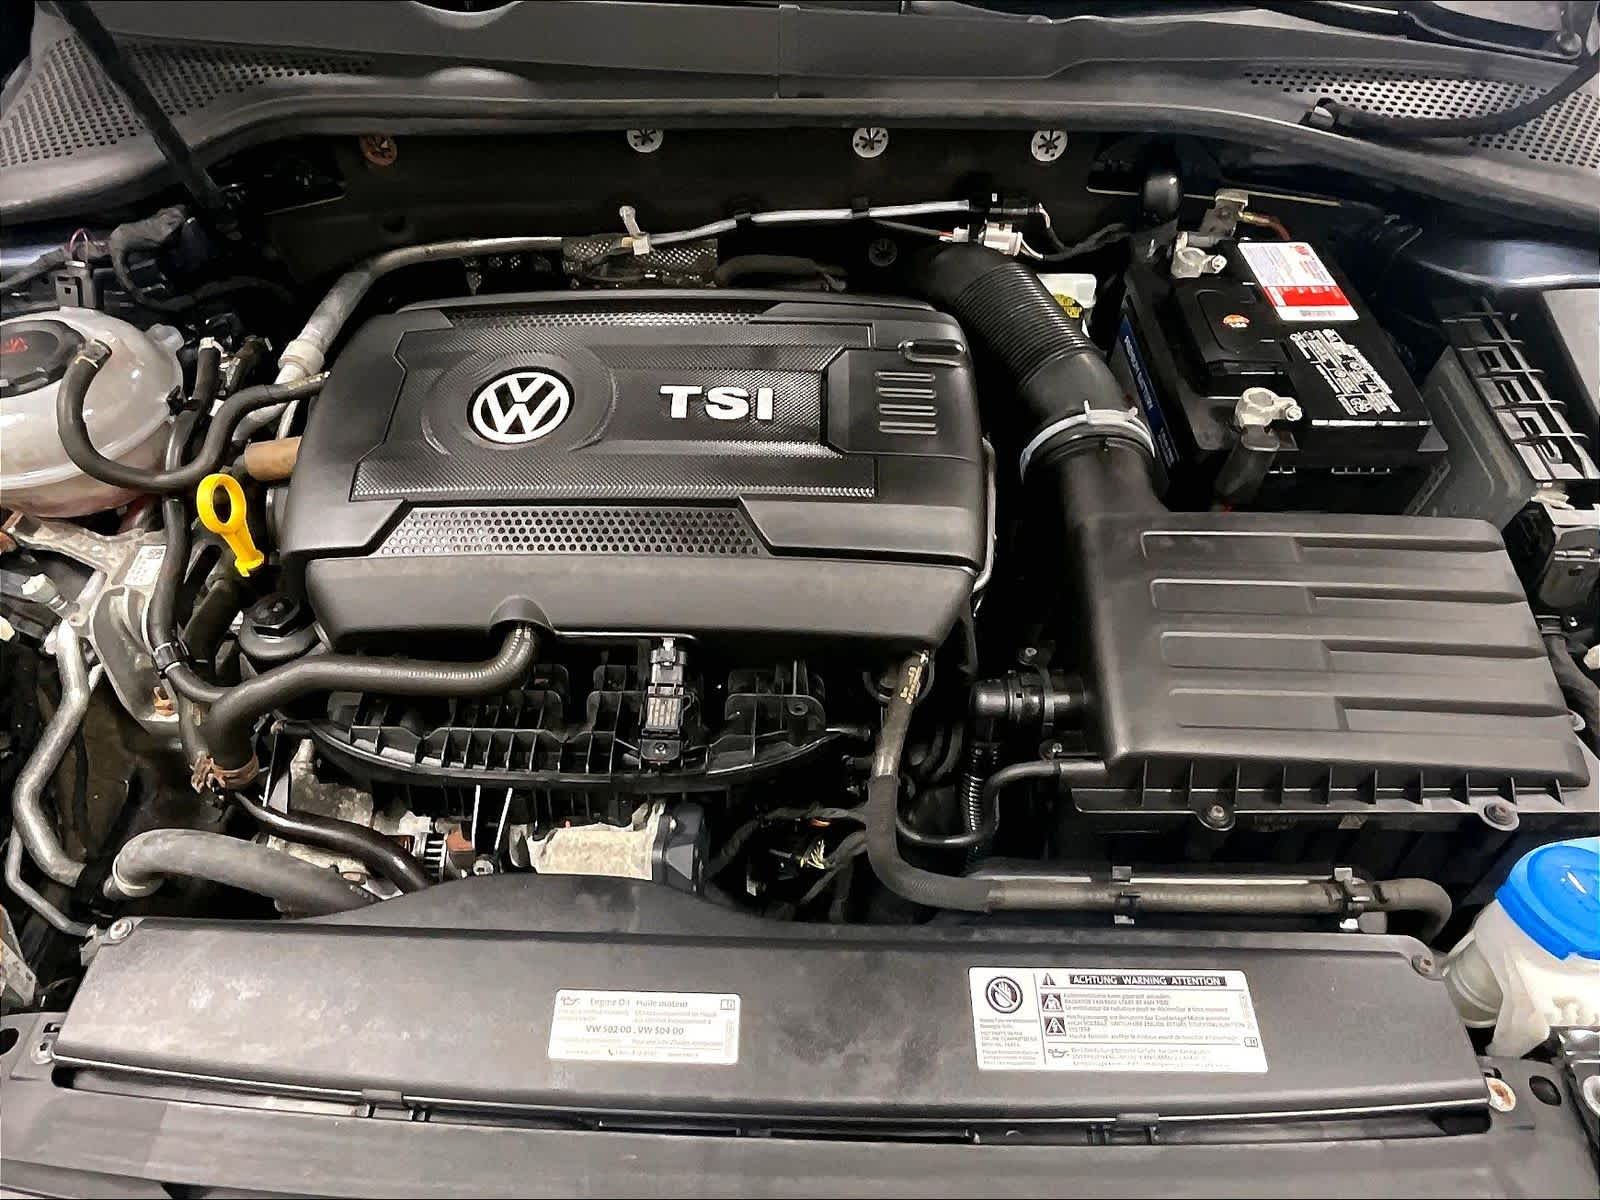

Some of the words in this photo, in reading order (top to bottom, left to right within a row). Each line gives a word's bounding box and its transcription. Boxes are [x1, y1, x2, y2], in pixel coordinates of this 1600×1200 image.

[660, 385, 774, 420] TSI
[1073, 975, 1118, 984] ACHTUNG
[1121, 975, 1168, 985] WARNING
[1171, 976, 1222, 986] ATTENTION
[586, 1024, 602, 1033] VW
[603, 1025, 618, 1034] 502
